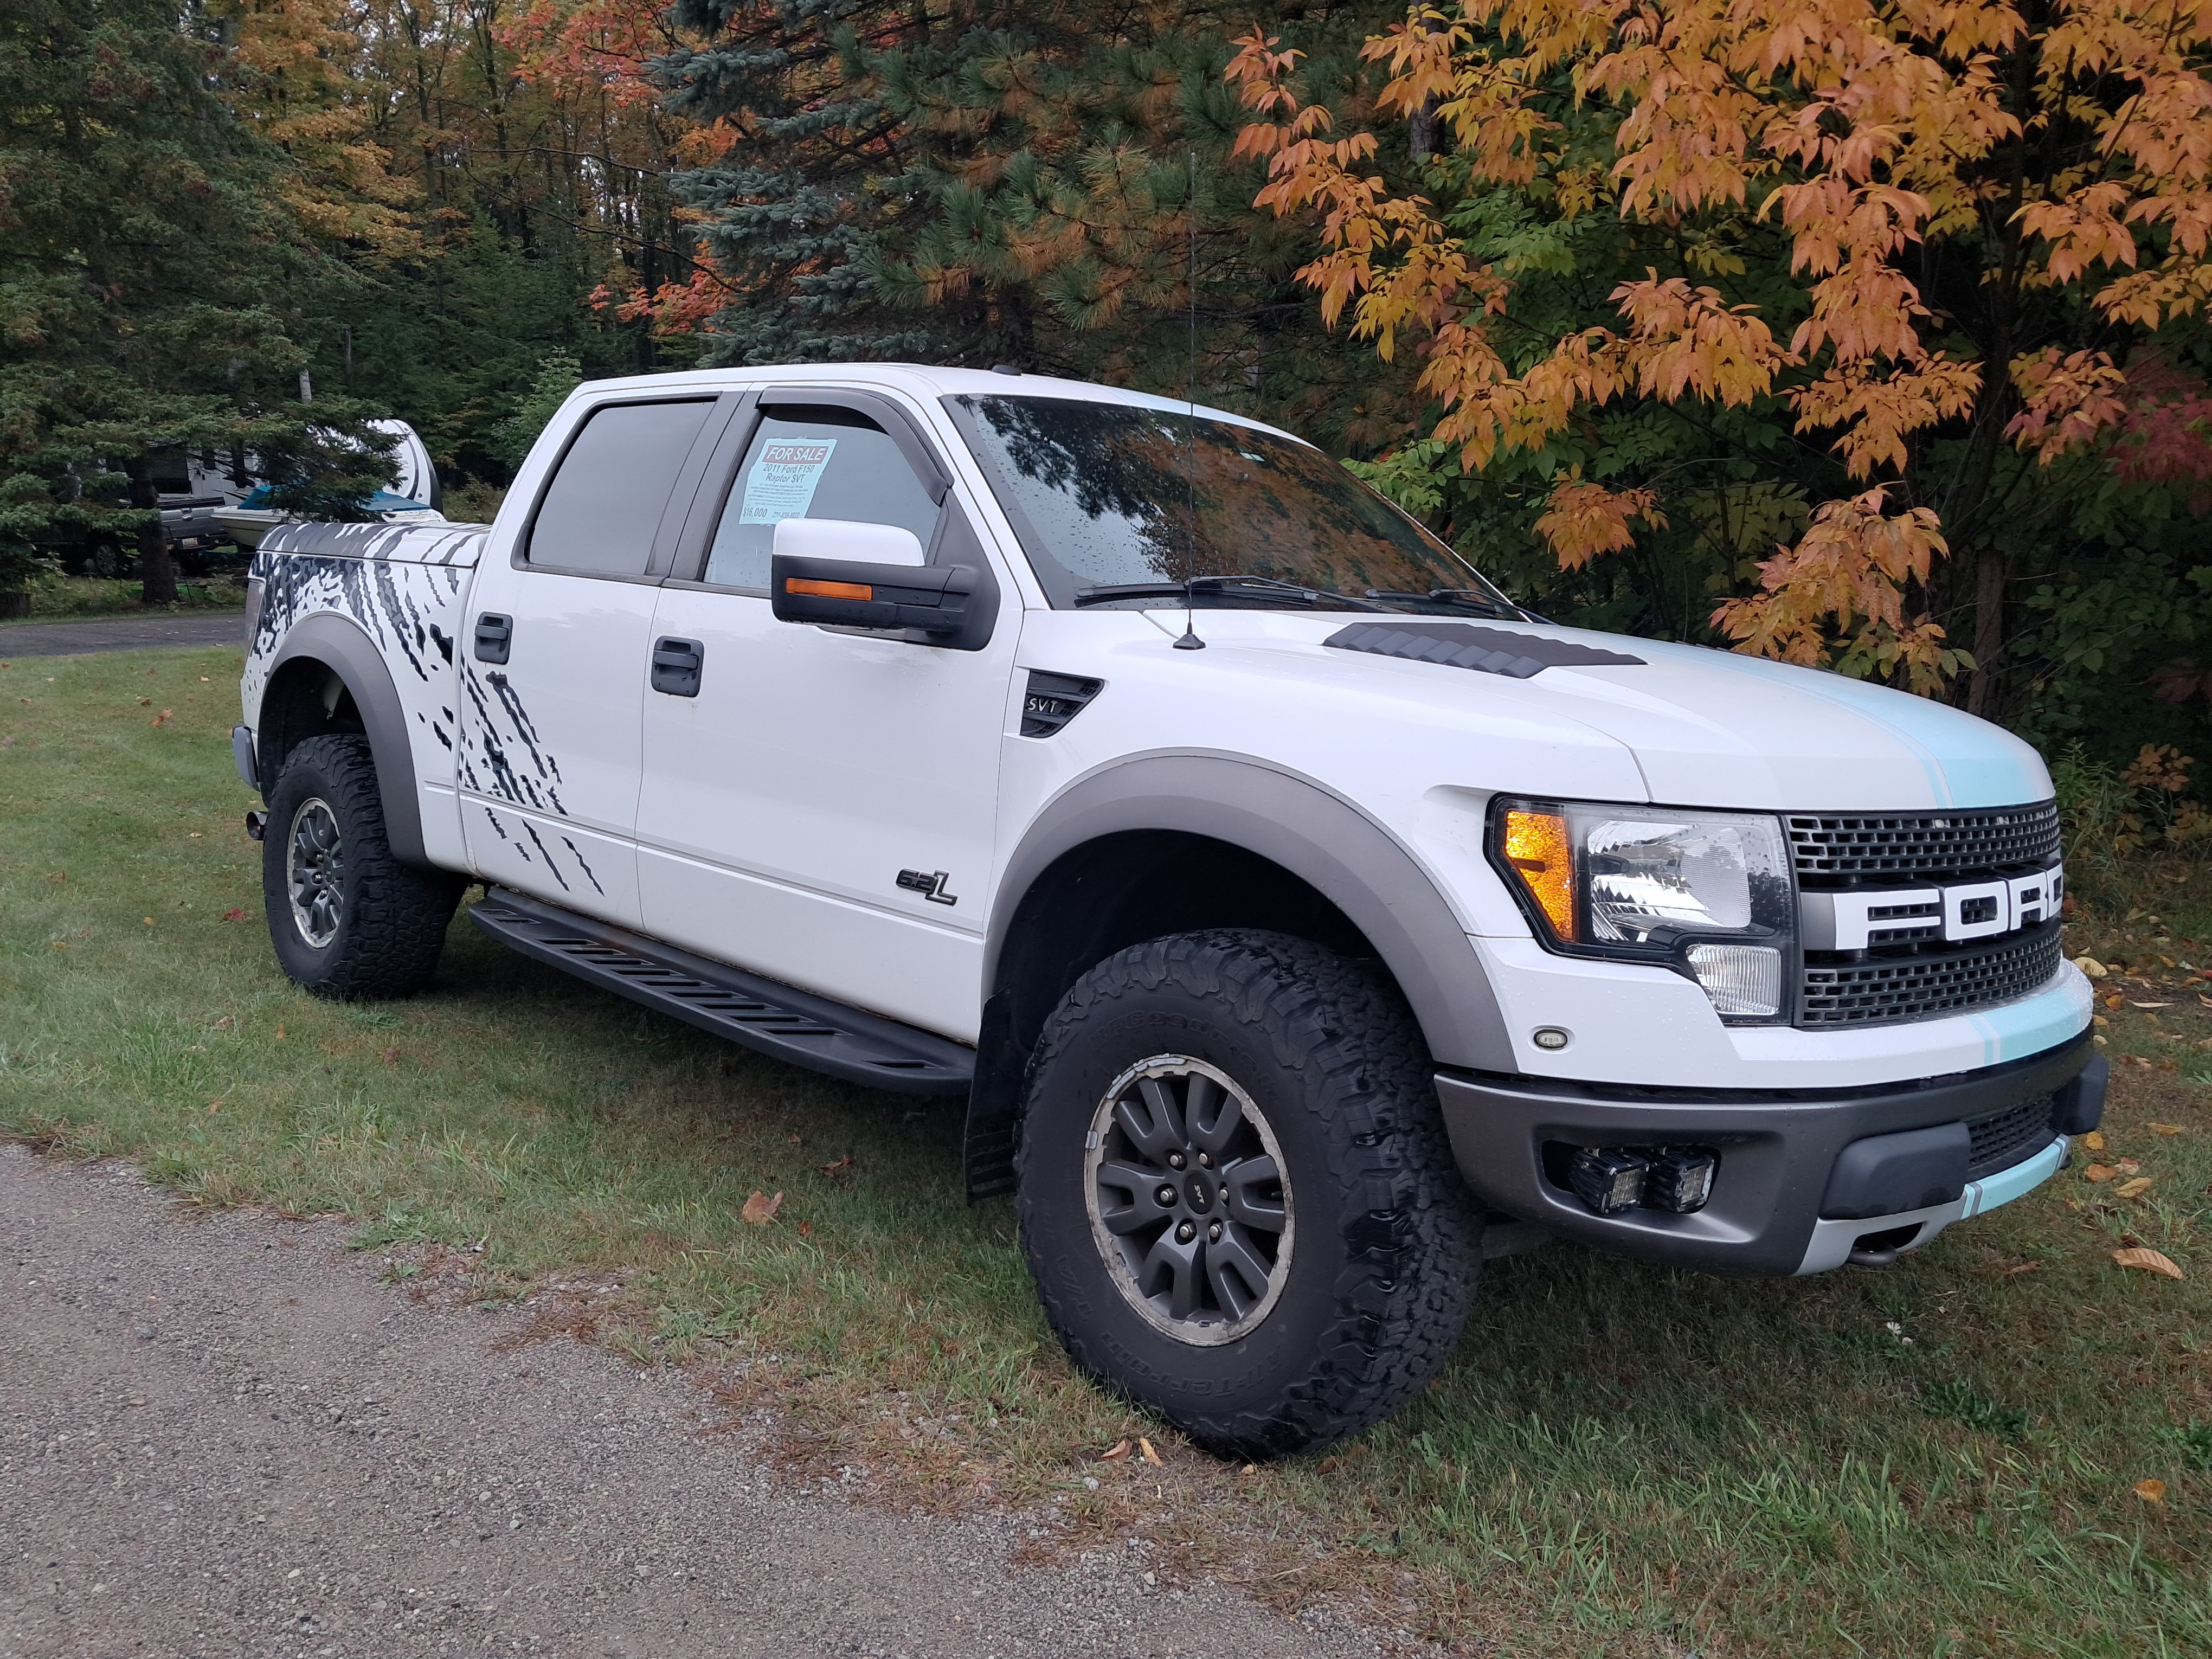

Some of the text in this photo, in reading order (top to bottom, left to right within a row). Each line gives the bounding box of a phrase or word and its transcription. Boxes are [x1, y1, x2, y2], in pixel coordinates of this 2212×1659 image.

[766, 447, 826, 461] FOR SALE
[762, 464, 815, 473] 2011 Ford F150
[765, 473, 806, 484] Raptor SVT
[743, 507, 768, 518] $16,000
[1027, 698, 1058, 713] SVT
[1194, 1184, 1205, 1204] SVT
